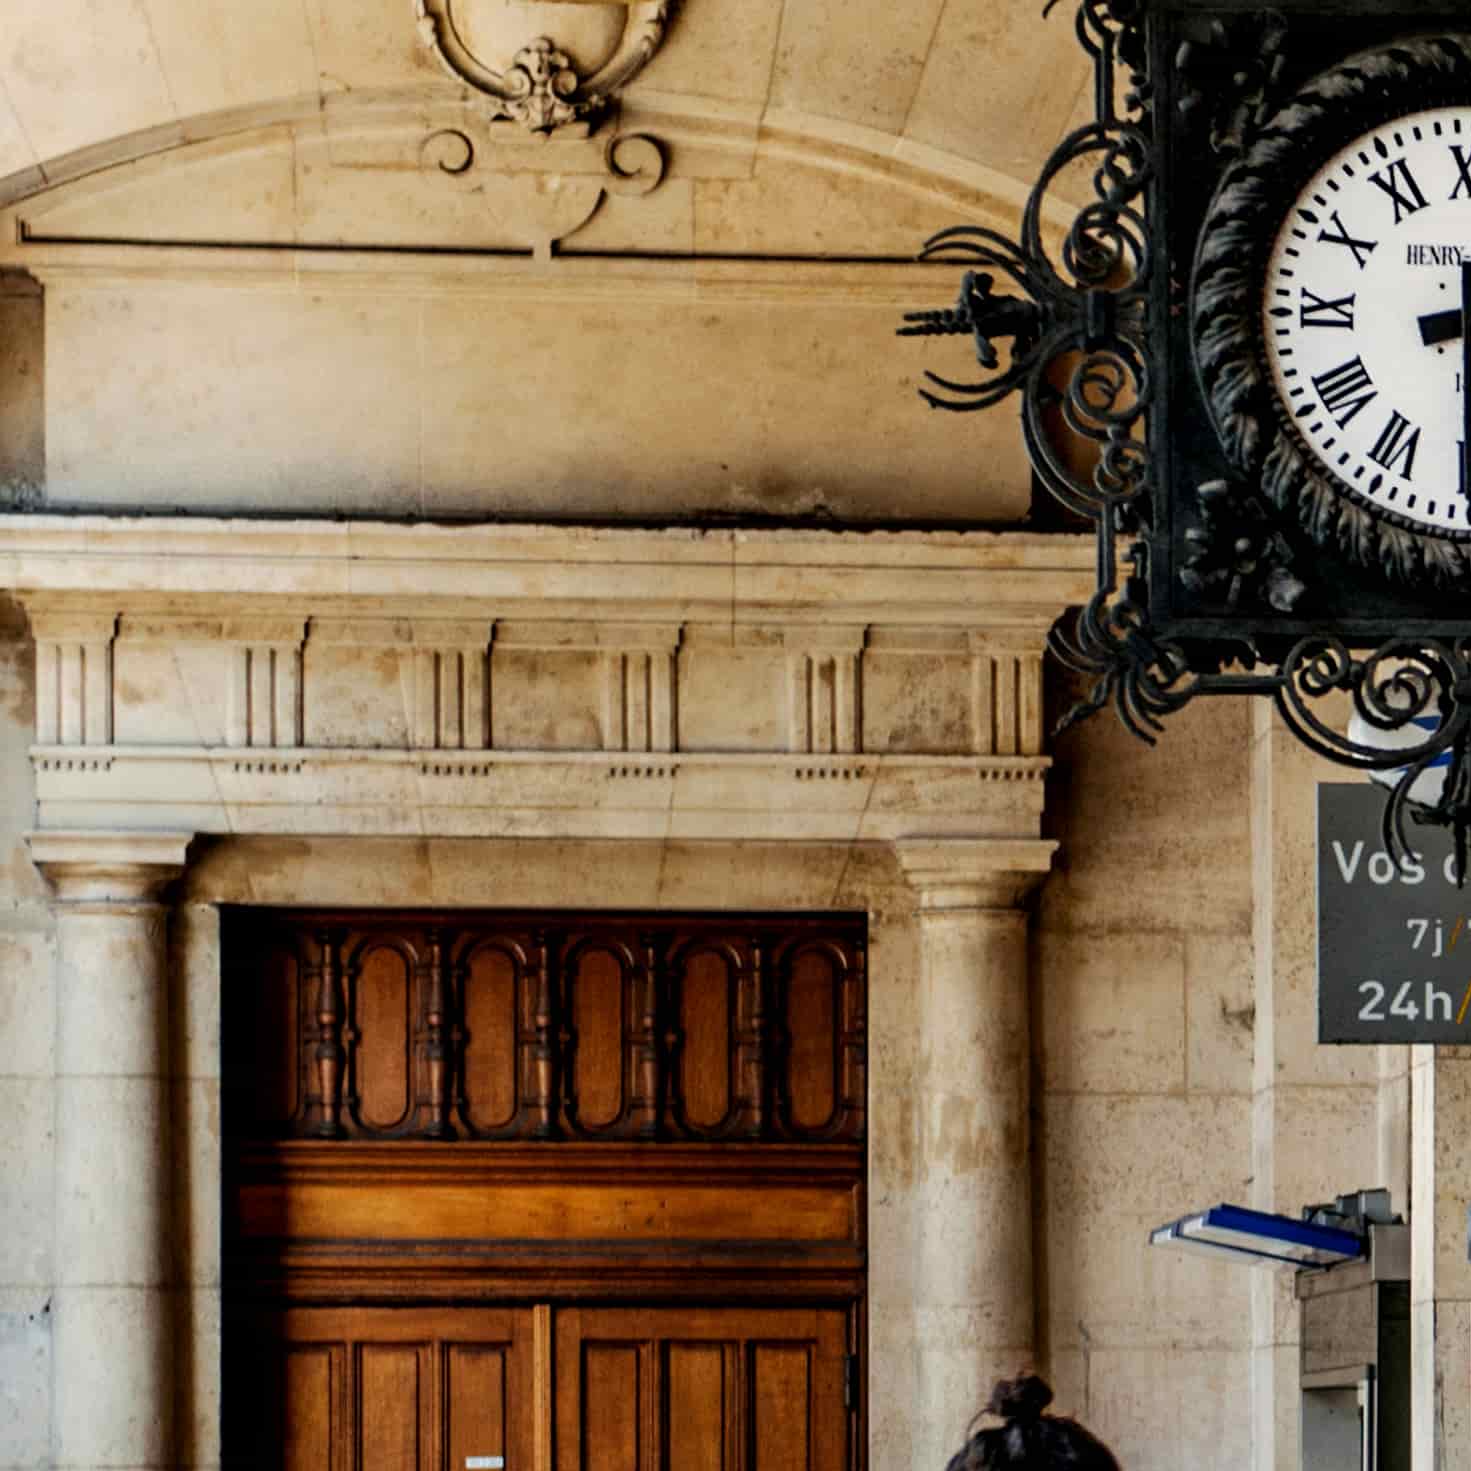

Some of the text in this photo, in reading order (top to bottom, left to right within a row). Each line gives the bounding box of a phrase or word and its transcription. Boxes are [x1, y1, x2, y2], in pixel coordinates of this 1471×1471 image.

[1367, 157, 1431, 225] XI
[1316, 210, 1379, 269] X
[1299, 287, 1356, 331] IX
[1311, 355, 1379, 431] VIII
[1366, 409, 1422, 481] VII
[1332, 840, 1426, 884] Vos
